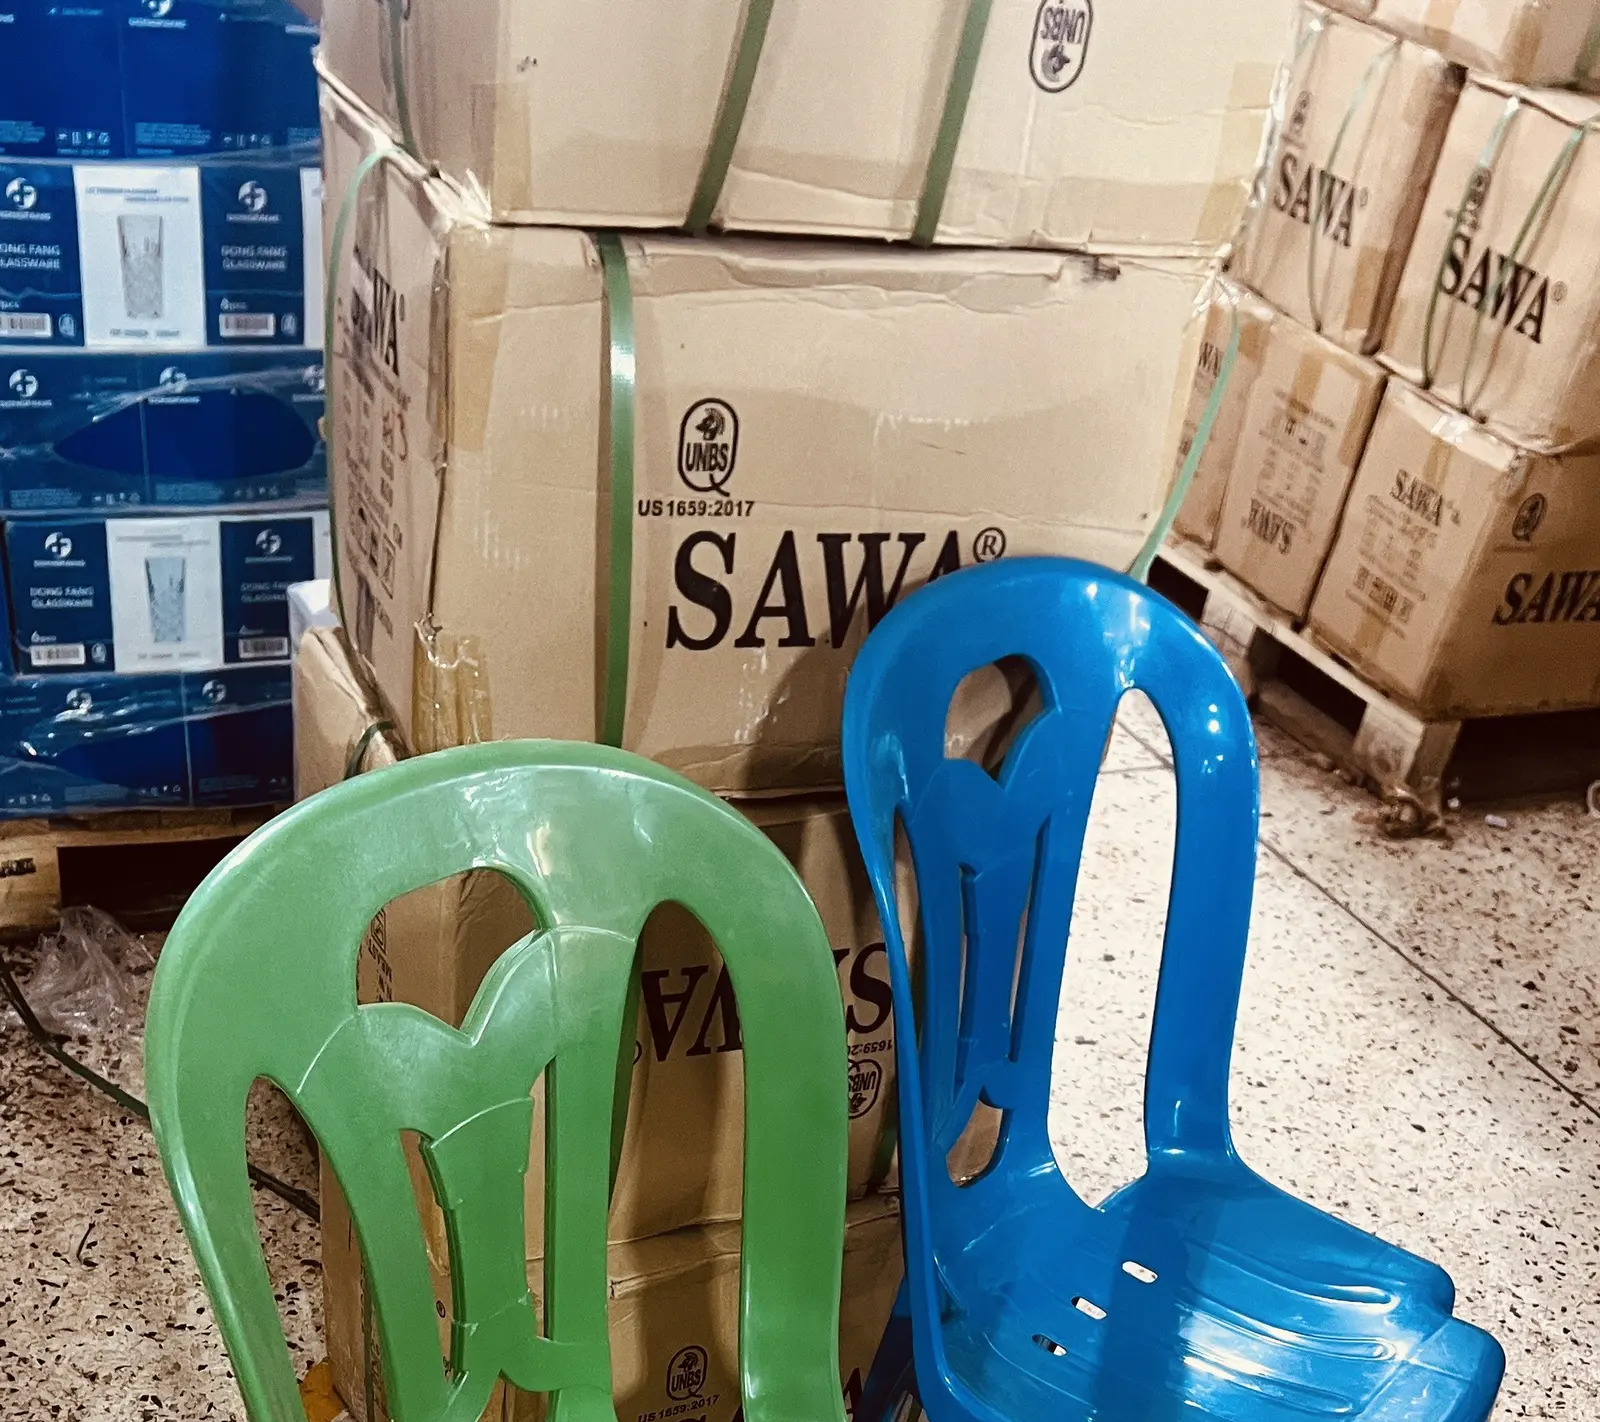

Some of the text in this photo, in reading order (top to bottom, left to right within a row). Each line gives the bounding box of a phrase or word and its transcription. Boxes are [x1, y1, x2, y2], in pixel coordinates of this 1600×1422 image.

[1040, 7, 1085, 44] UNBS
[0, 243, 26, 255] ONG
[0, 257, 60, 269] LASSWARE
[685, 442, 729, 472] UNBS
[637, 499, 755, 517] US 1659:2017
[848, 1039, 892, 1056] 1659:2
[671, 1370, 702, 1393] UNBS
[657, 1394, 721, 1421] 1659:2017
